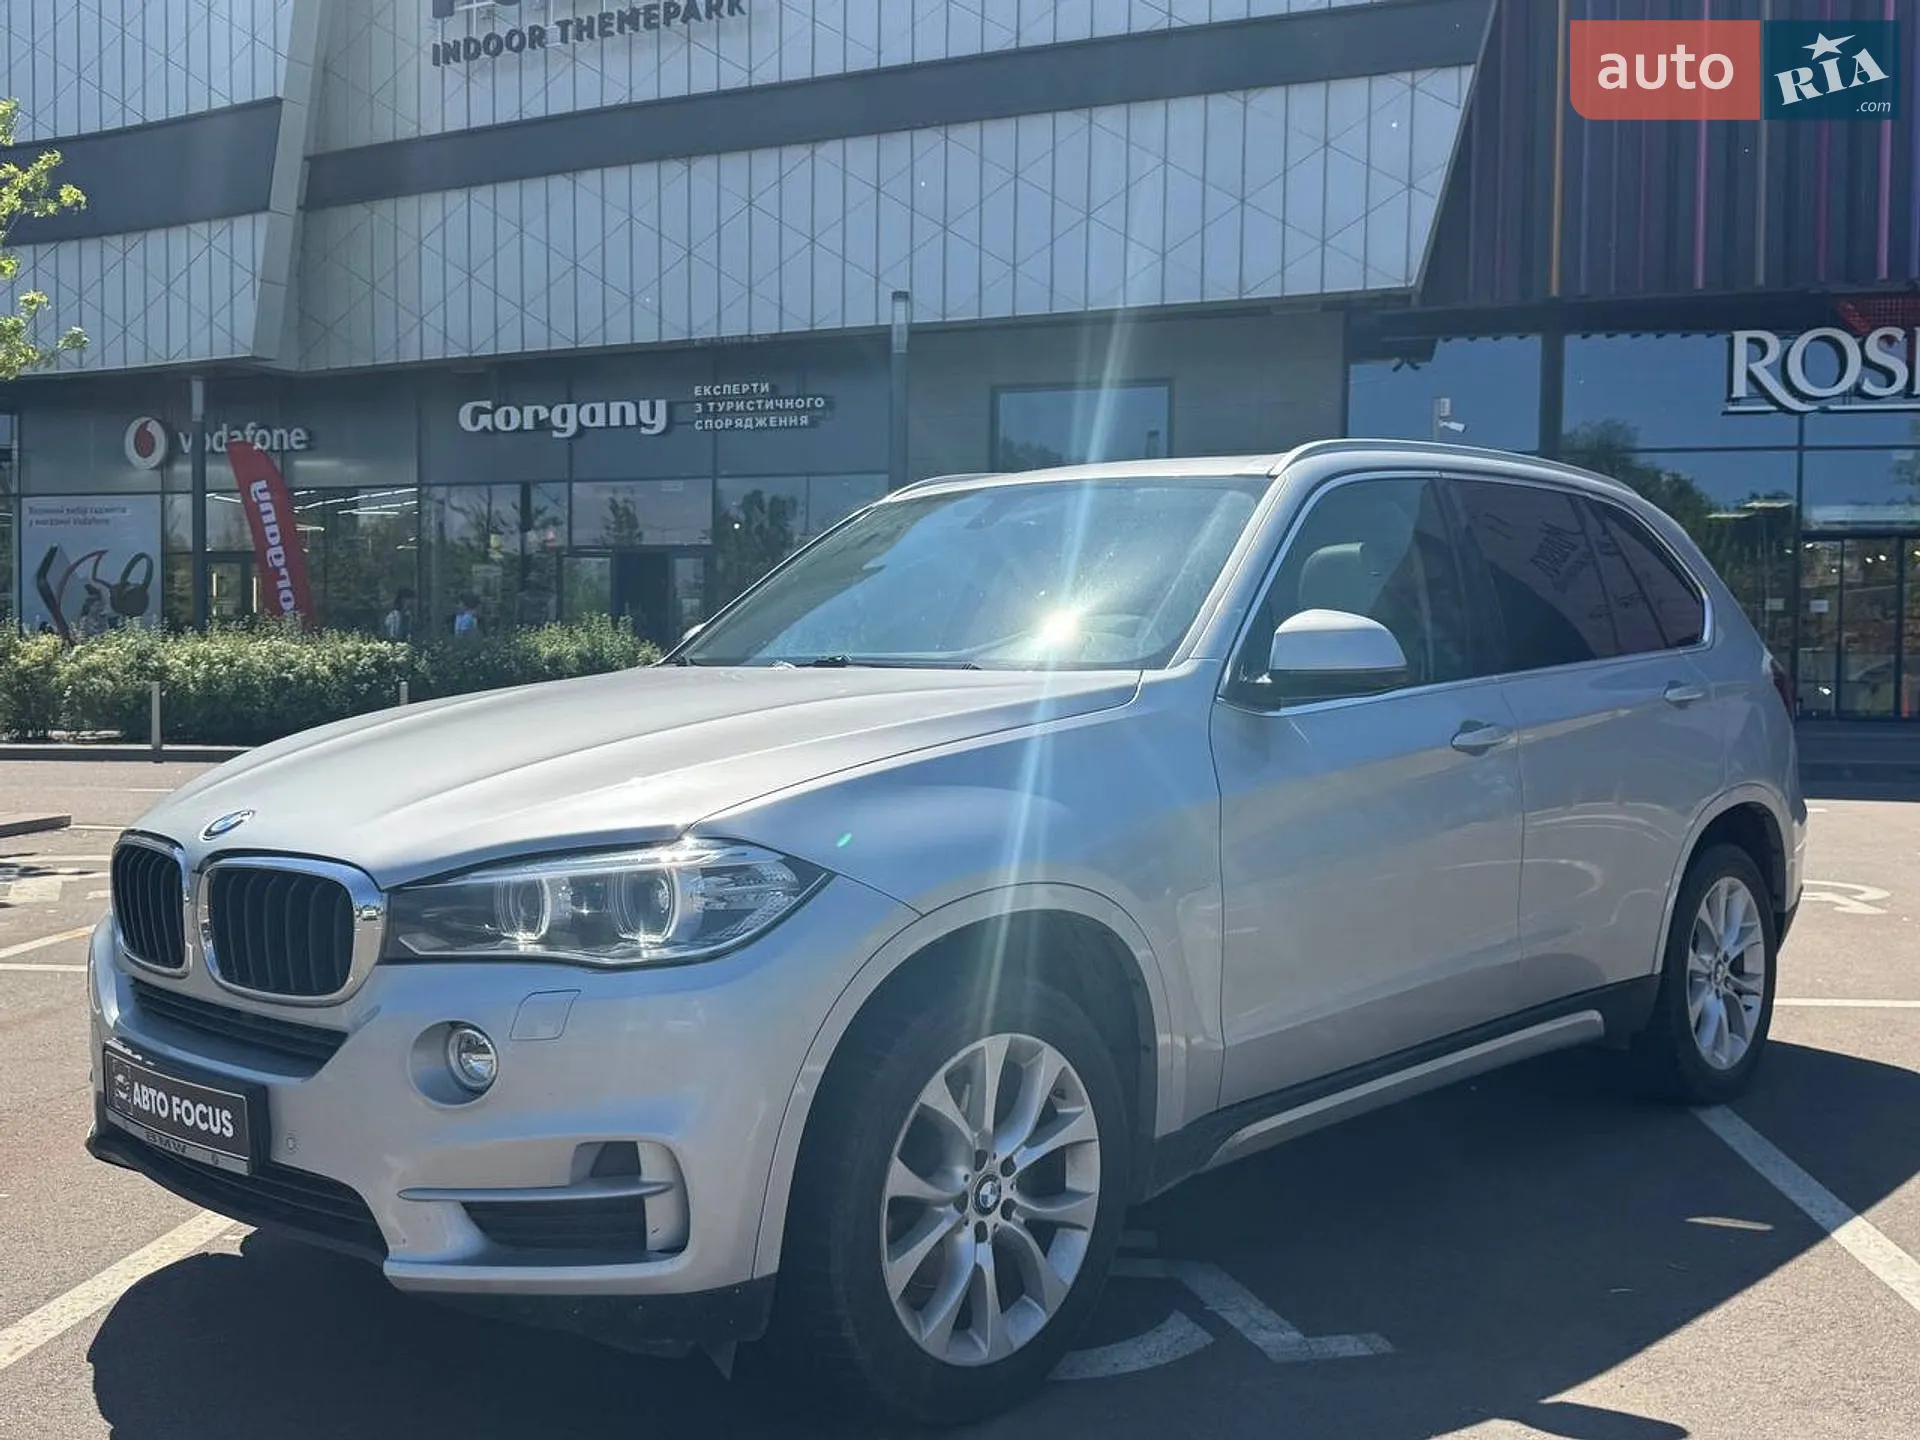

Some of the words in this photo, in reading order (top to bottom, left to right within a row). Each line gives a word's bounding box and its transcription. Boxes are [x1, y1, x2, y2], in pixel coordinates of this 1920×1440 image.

[432, 23, 547, 67] INDOOR
[555, 0, 746, 44] THEMEPARK
[693, 382, 770, 397] ЕКСПЕРТИ
[1731, 326, 1920, 412] ROS
[458, 399, 668, 438] Gorgany
[694, 414, 810, 431] СПОРЯДЖЕННЯ
[707, 397, 826, 413] ТУРИСТИЧНОГО
[249, 479, 296, 613] organy
[172, 1095, 234, 1138] FOCUS
